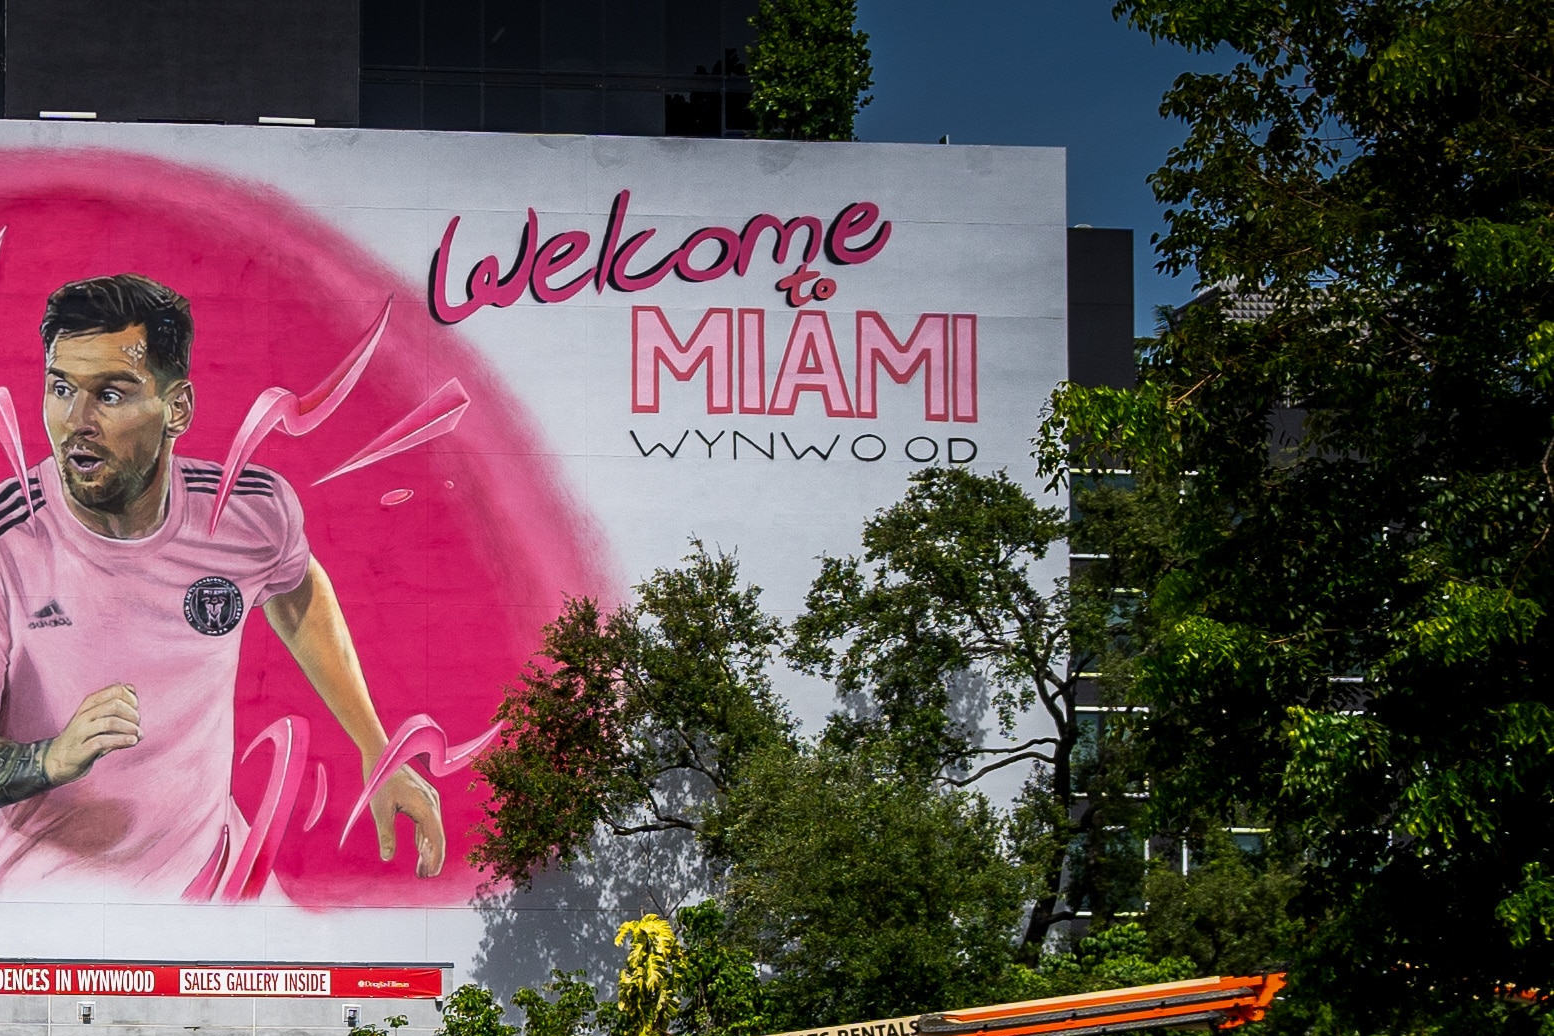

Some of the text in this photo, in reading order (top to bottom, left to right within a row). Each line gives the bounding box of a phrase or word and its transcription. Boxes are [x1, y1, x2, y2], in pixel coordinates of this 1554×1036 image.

[428, 189, 892, 325] Welcome
[776, 264, 837, 307] to
[631, 305, 978, 423] MIAMI
[629, 428, 978, 464] WYNWOOD
[55, 969, 72, 991] IN
[77, 969, 155, 993] WYNWOOD
[184, 972, 326, 992] SALES GALLERY INSIDE
